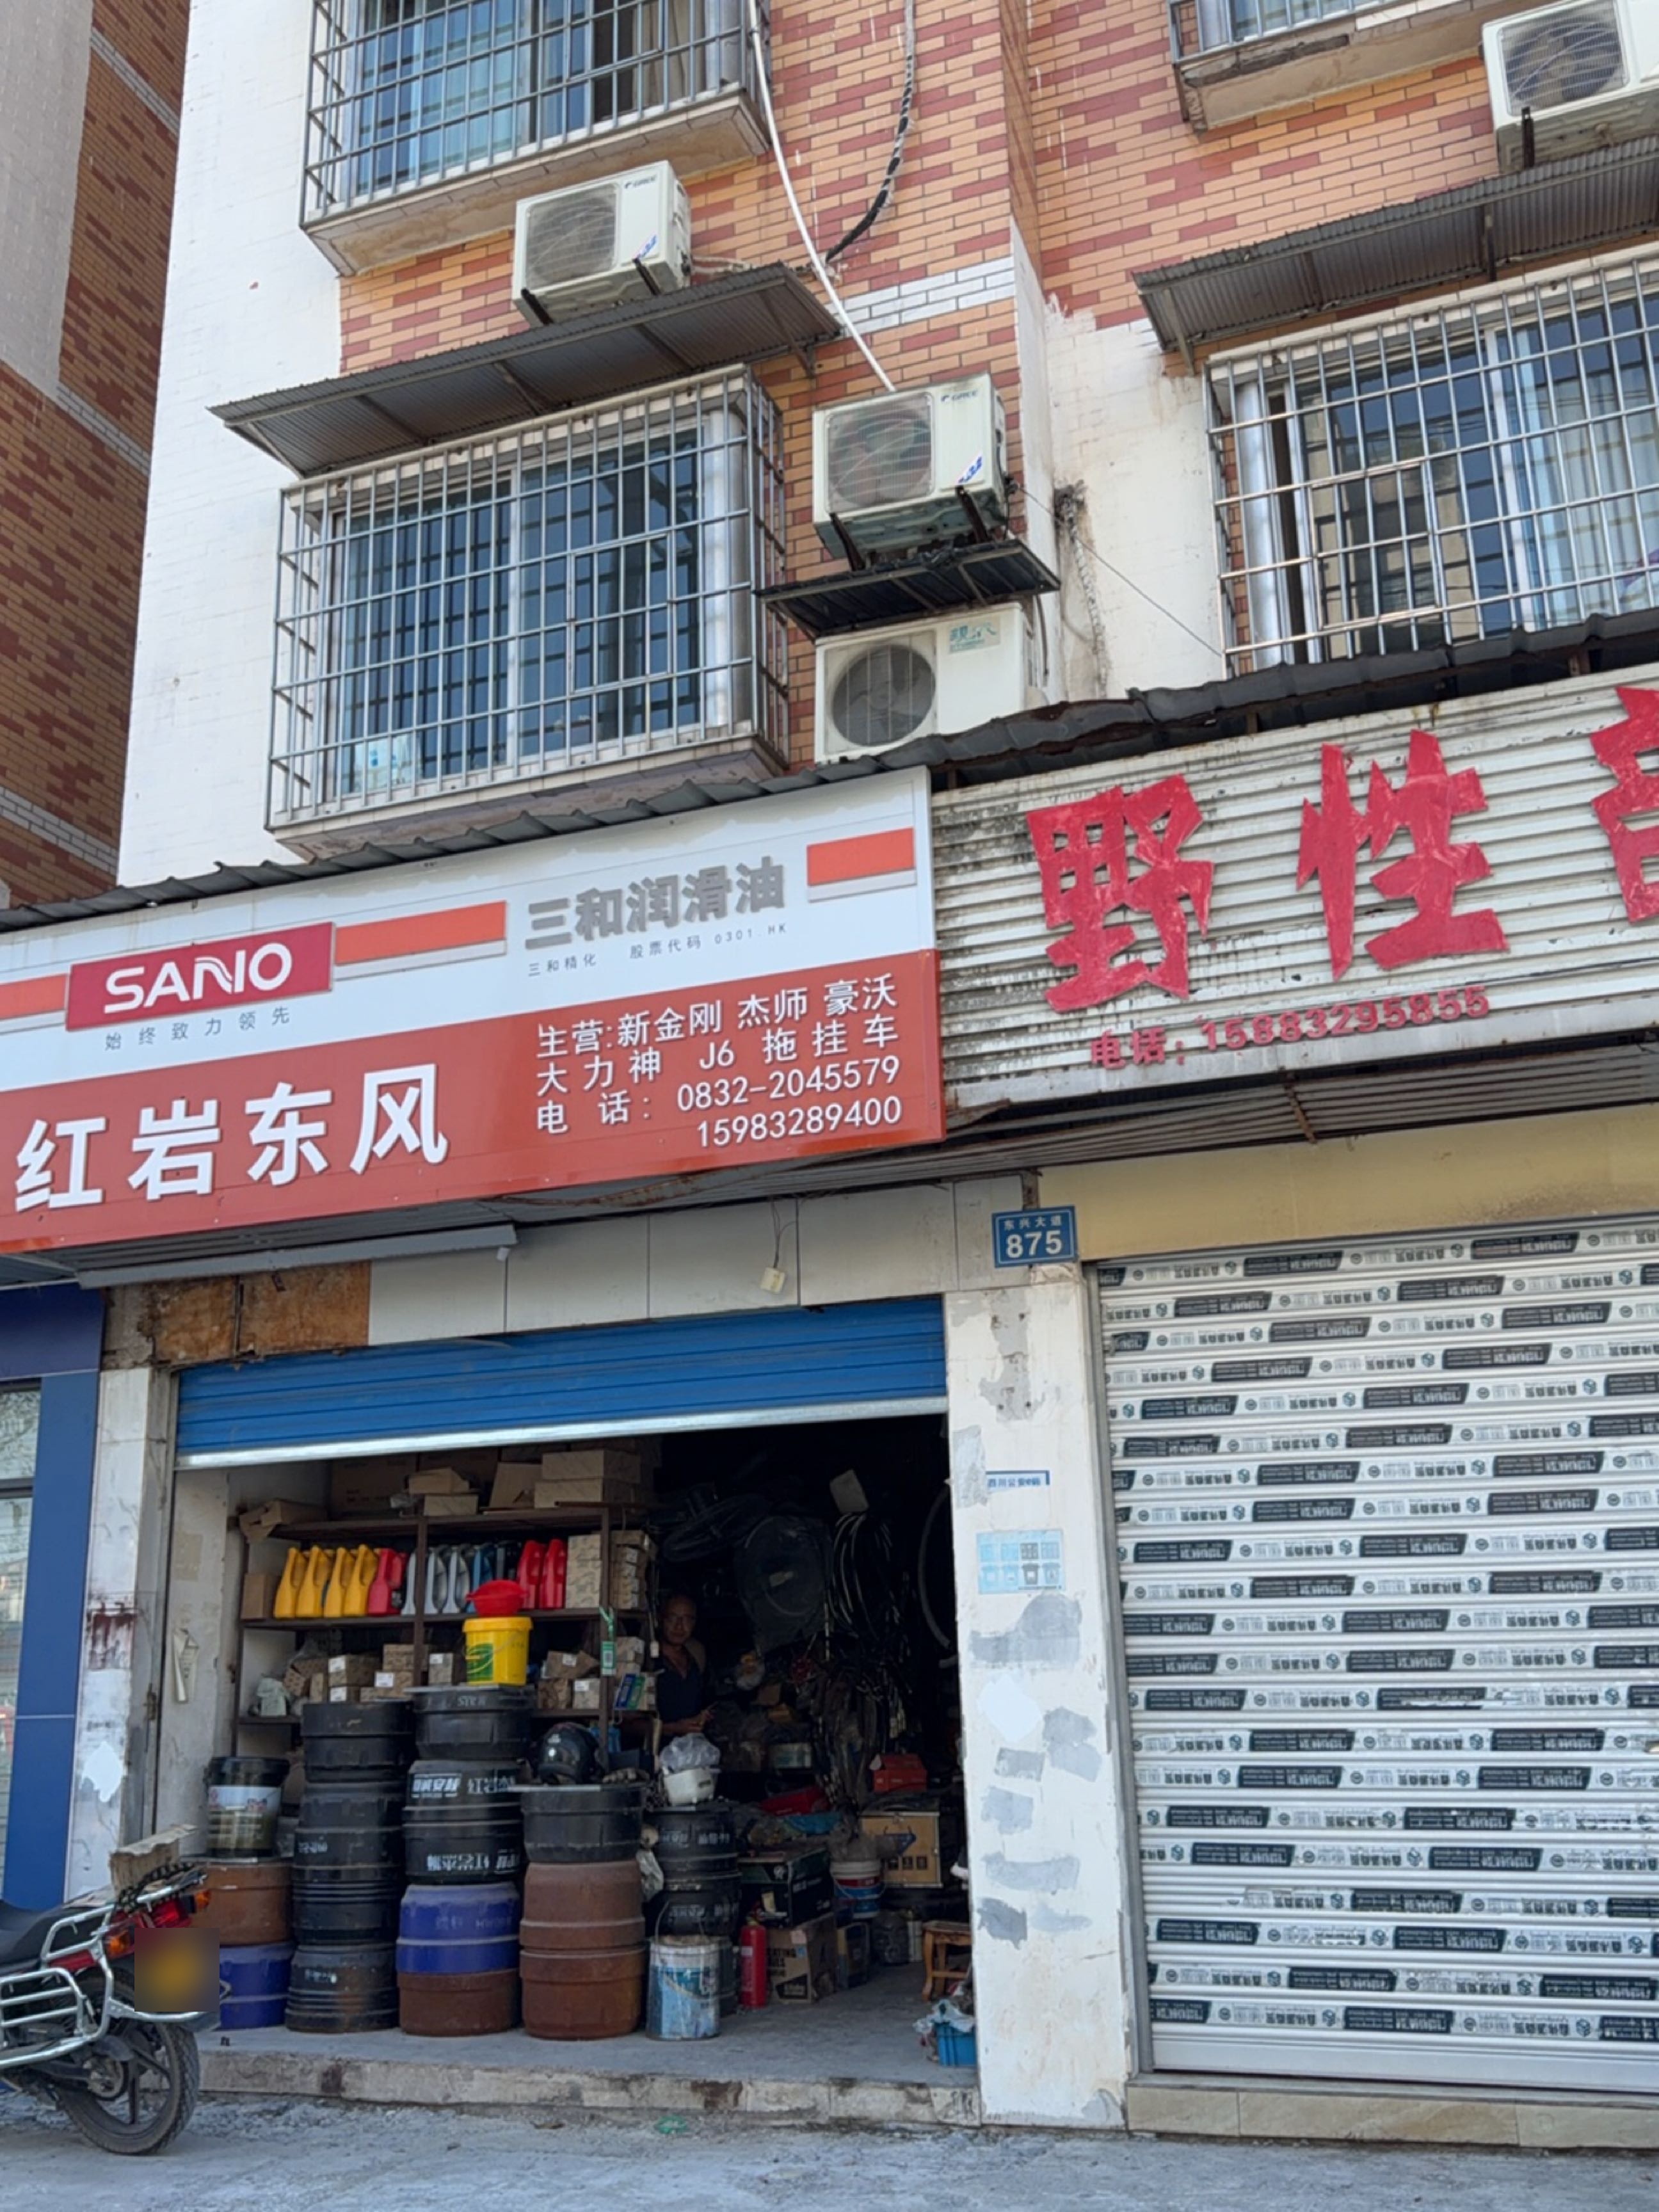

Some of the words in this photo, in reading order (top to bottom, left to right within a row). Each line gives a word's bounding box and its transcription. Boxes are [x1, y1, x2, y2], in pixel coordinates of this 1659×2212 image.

[525, 856, 785, 949] 三和润滑油
[528, 953, 597, 977] 三和精化
[630, 935, 702, 960] 股票代码
[104, 1006, 290, 1052] 始终致力领先
[737, 987, 809, 1029] 杰师
[824, 972, 897, 1017] 豪沃
[1201, 984, 1491, 1051] 15883295855
[536, 1047, 662, 1096] 大力神
[699, 1041, 735, 1070] J6
[762, 1013, 899, 1064] 拖挂车
[677, 1055, 900, 1112] 0832-2045579
[15, 1062, 448, 1213] 红岩东风
[698, 1095, 902, 1146] 15983289400
[1006, 1230, 1063, 1258] 875
